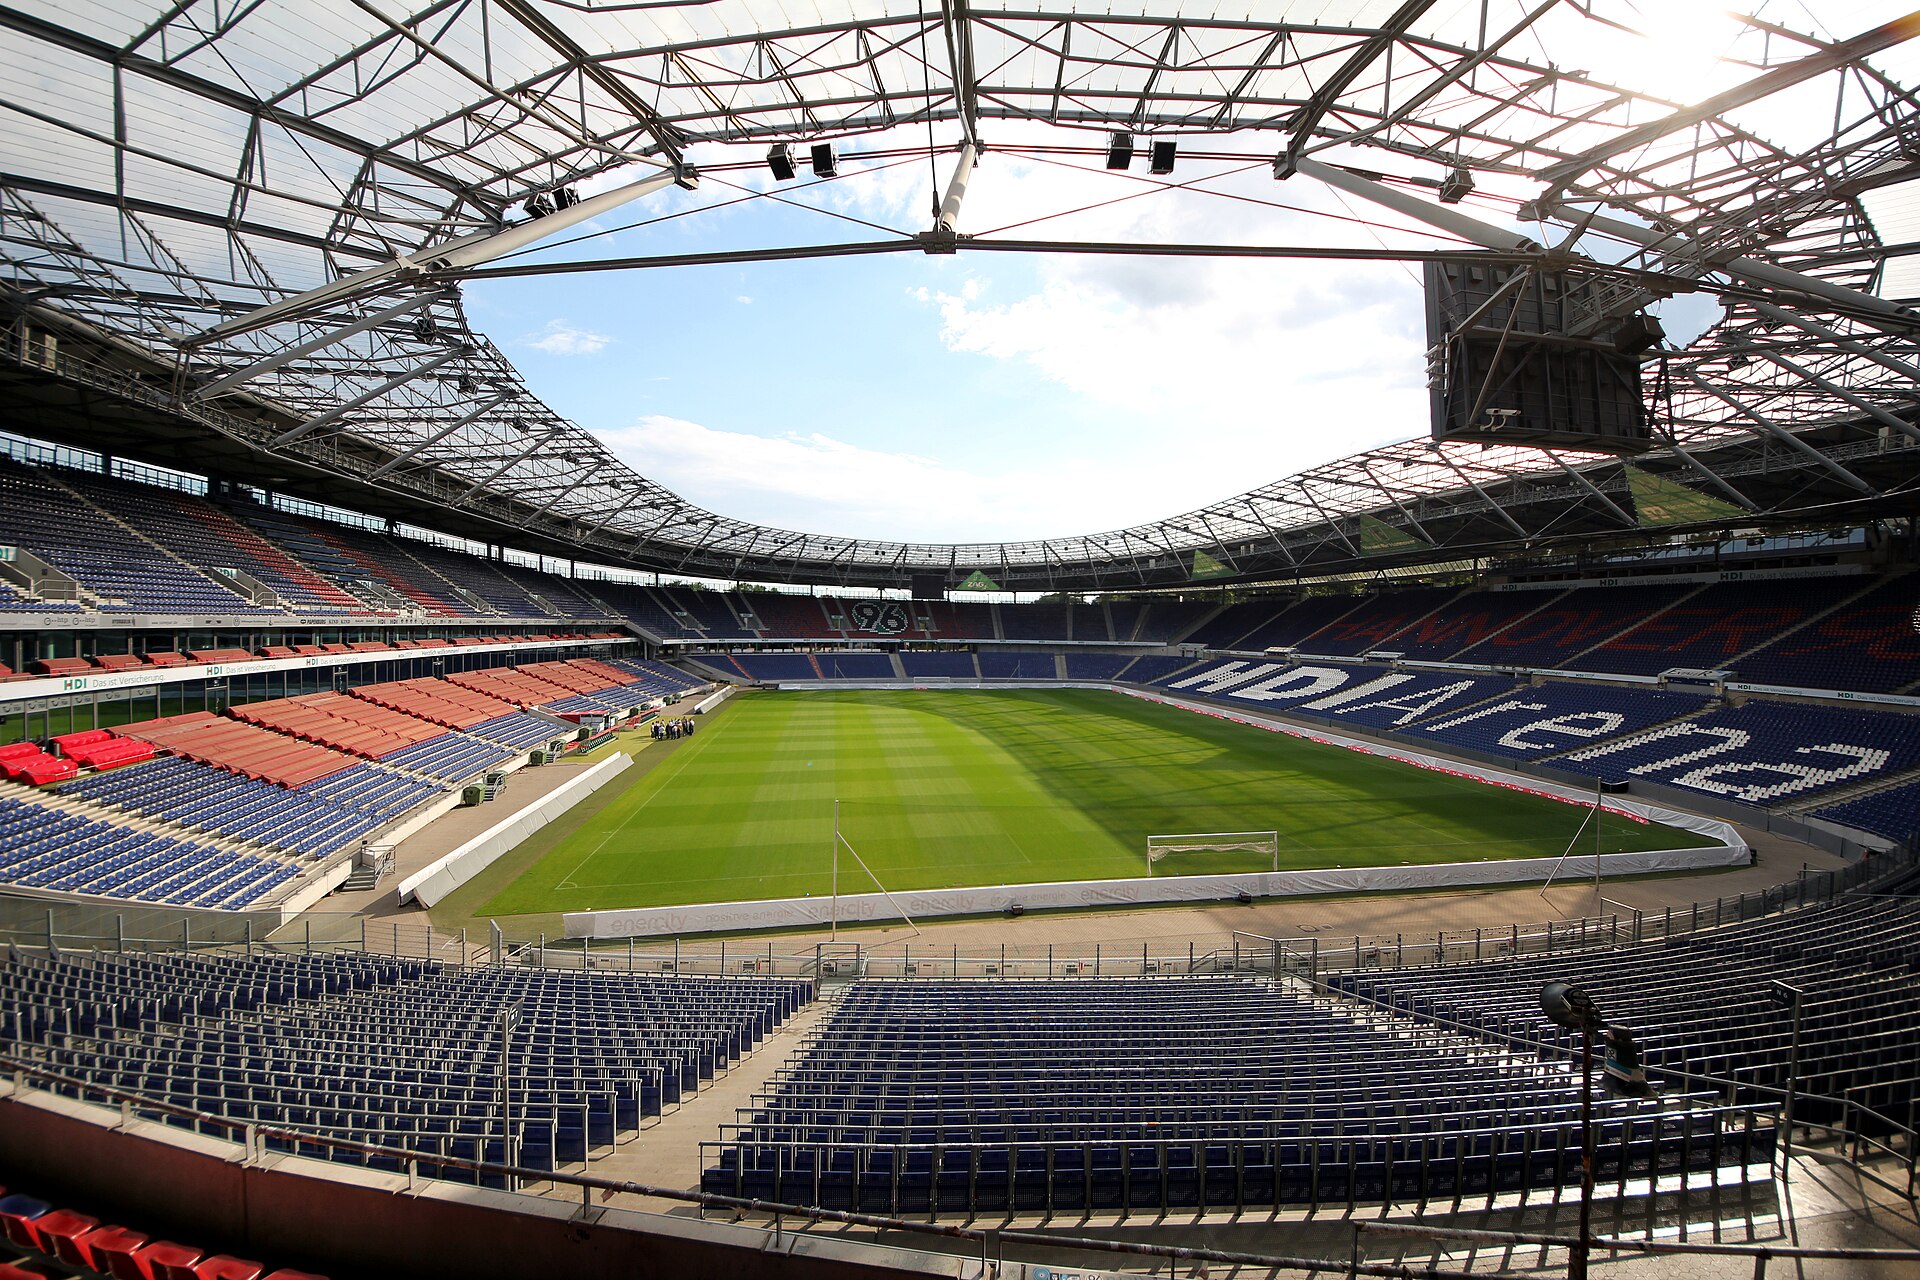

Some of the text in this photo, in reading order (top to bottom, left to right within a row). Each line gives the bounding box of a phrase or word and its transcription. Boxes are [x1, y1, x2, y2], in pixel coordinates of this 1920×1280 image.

[1720, 571, 1743, 580] HDI
[1600, 579, 1618, 587] HDI
[851, 600, 908, 634] 96
[1306, 607, 1804, 653] HANNOVER
[306, 658, 318, 666] HDI
[207, 666, 223, 676] HDI
[64, 678, 87, 690] HDI
[92, 679, 107, 688] Das
[108, 678, 117, 686] ist
[610, 912, 688, 932] enercity
[705, 911, 749, 923] positive
